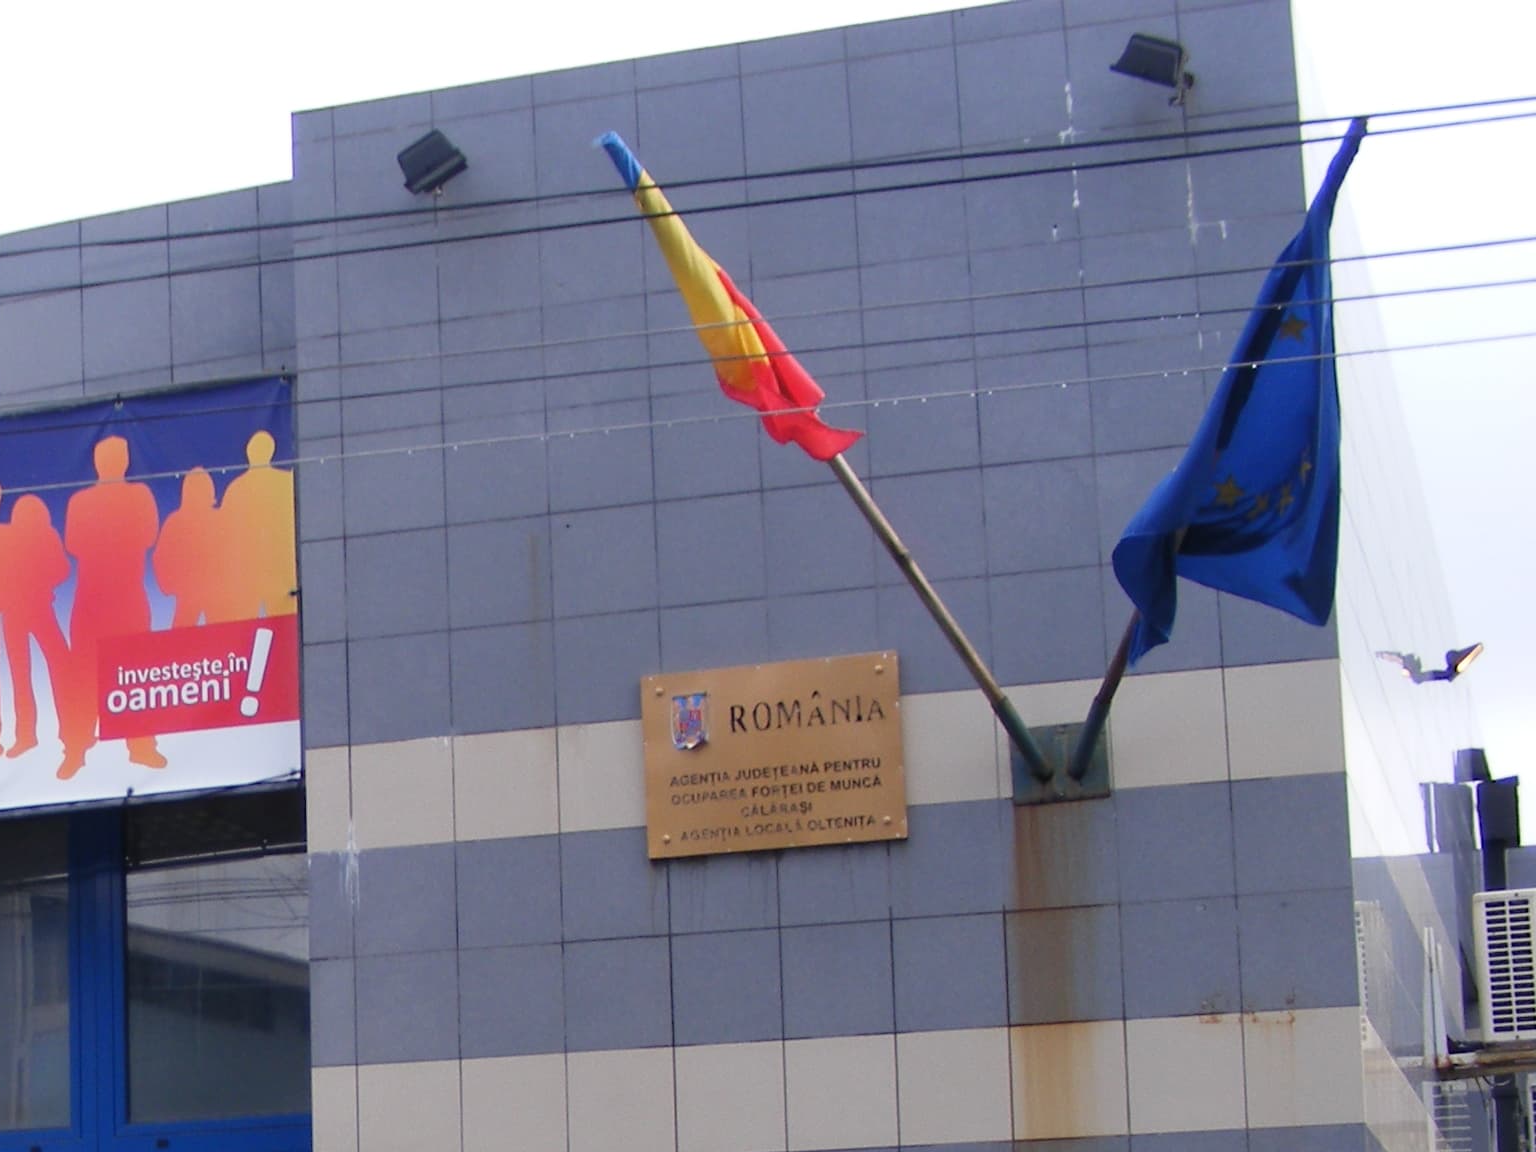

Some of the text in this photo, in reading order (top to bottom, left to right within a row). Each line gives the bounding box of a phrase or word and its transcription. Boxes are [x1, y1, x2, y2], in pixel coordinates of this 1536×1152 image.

[227, 652, 248, 672] în
[730, 690, 885, 733] ROMÂNIA
[823, 757, 881, 773] PENTRU
[672, 787, 747, 805] OCUPAREA
[807, 780, 825, 794] DE
